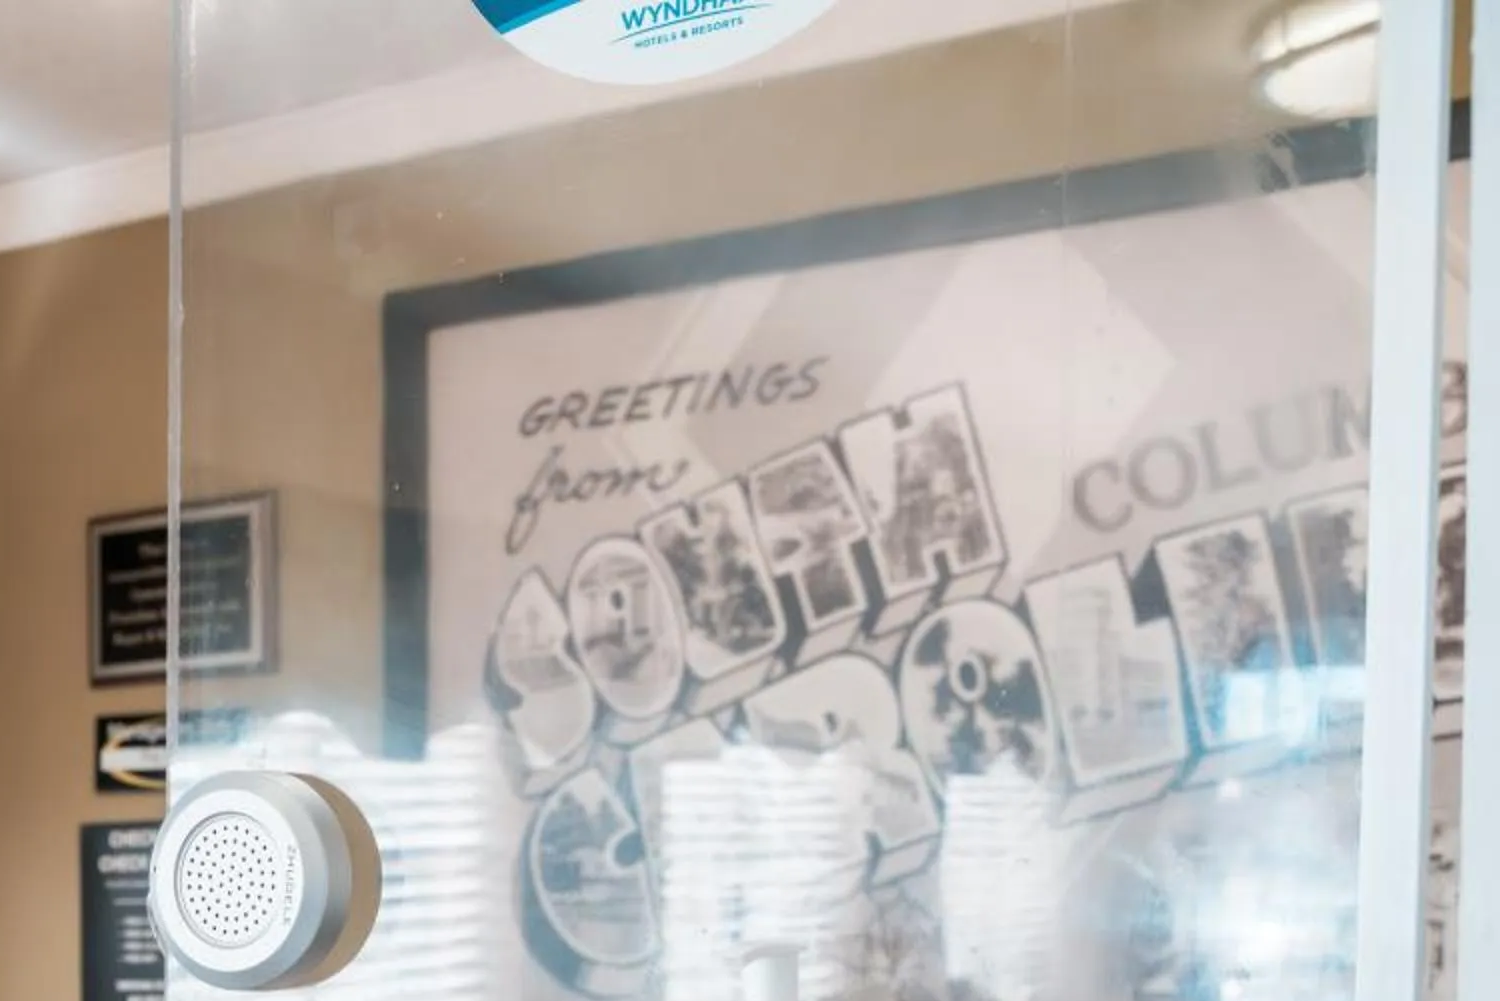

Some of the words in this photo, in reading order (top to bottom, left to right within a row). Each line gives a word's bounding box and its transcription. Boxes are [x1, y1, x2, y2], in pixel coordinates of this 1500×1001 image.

[621, 0, 748, 30] WYNDH
[633, 33, 677, 49] HOTELS
[692, 16, 744, 36] RESORTS
[518, 356, 831, 438] GREETINGS
[504, 445, 690, 555] from
